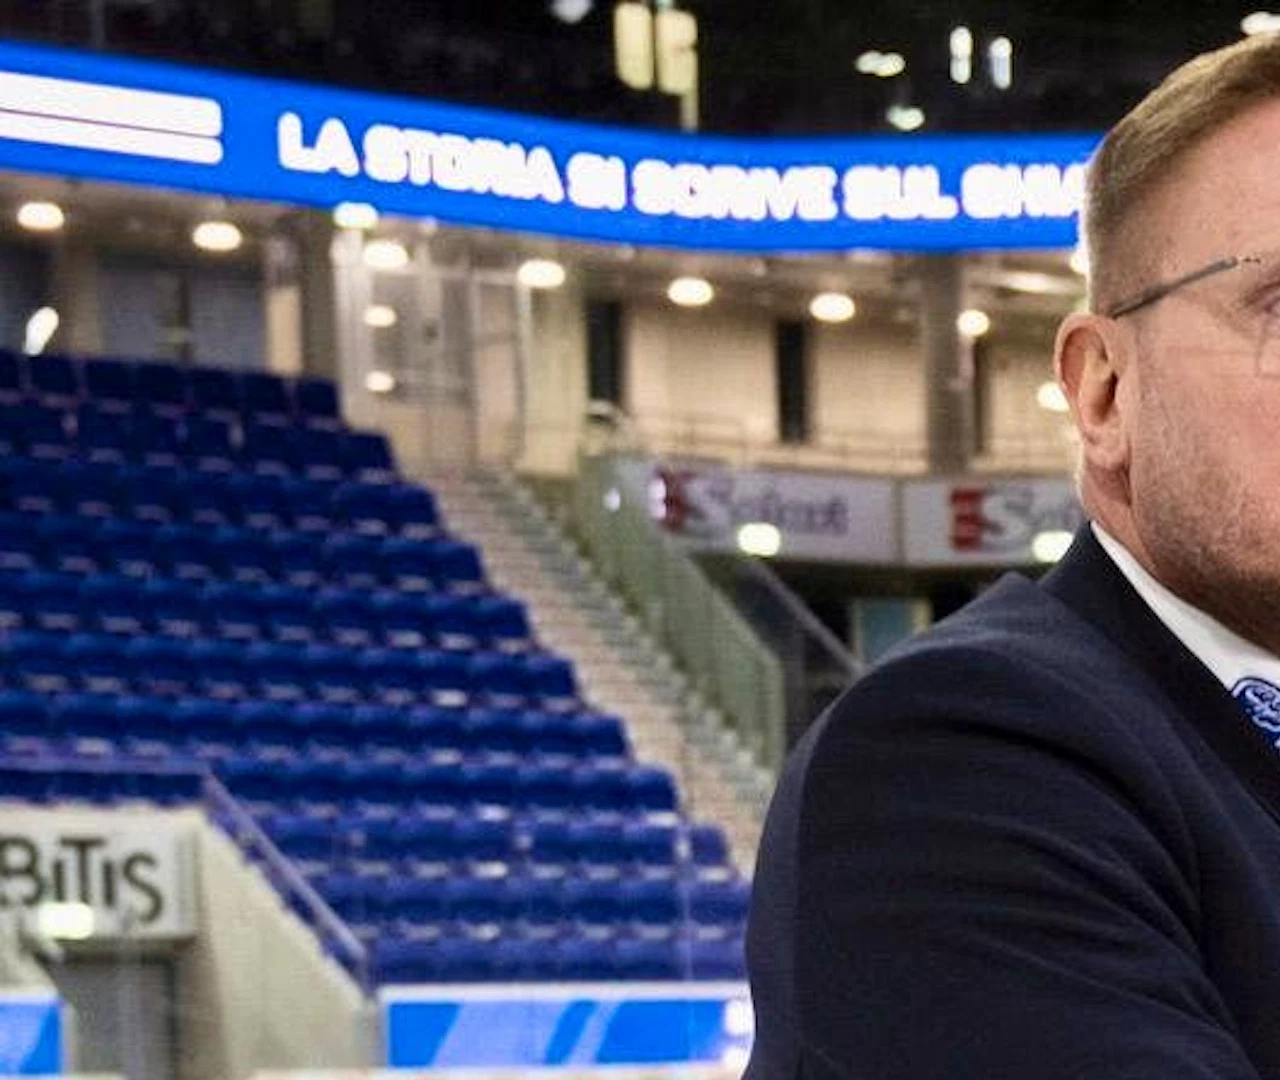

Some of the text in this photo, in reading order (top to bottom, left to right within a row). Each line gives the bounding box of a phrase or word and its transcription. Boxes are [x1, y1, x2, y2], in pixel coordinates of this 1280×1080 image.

[278, 112, 360, 177] LA
[363, 124, 564, 203] STORIA
[567, 152, 626, 211] SI
[632, 159, 839, 221] SCRIVE
[842, 165, 959, 220] SUL
